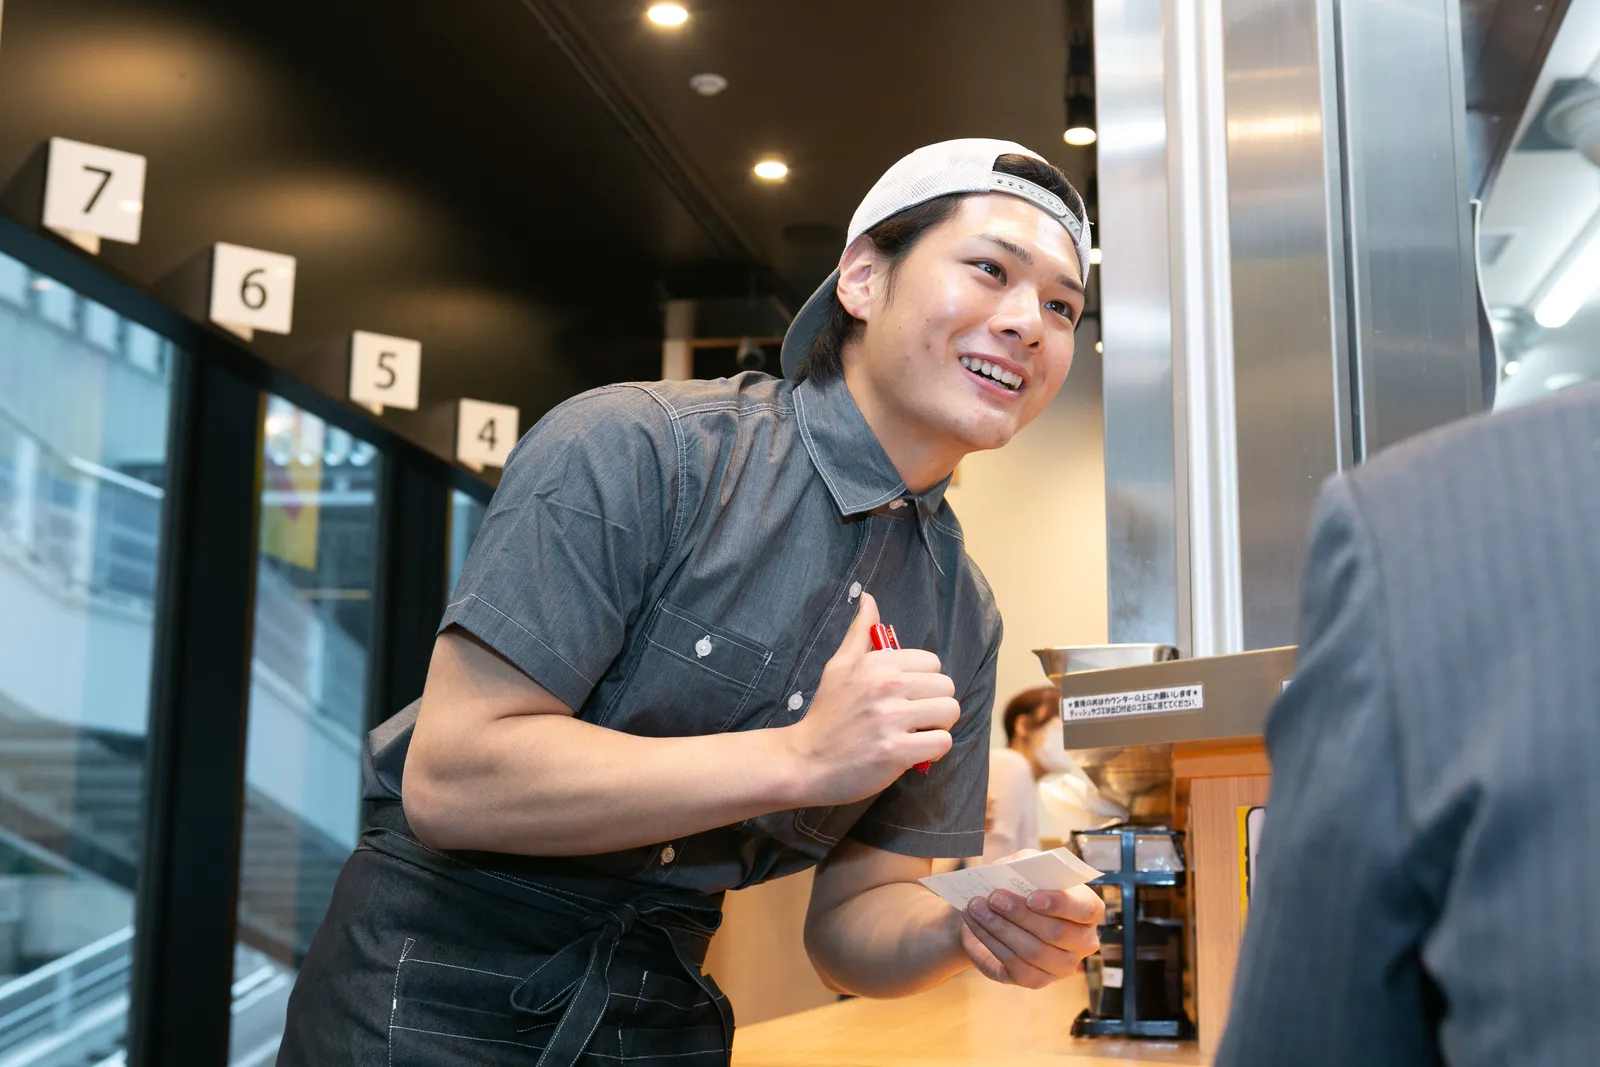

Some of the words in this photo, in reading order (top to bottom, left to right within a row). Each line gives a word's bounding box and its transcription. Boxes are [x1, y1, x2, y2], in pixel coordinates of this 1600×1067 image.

[82, 166, 113, 214] 7
[240, 268, 267, 310] 6
[373, 352, 397, 389] 5
[478, 417, 498, 451] 4
